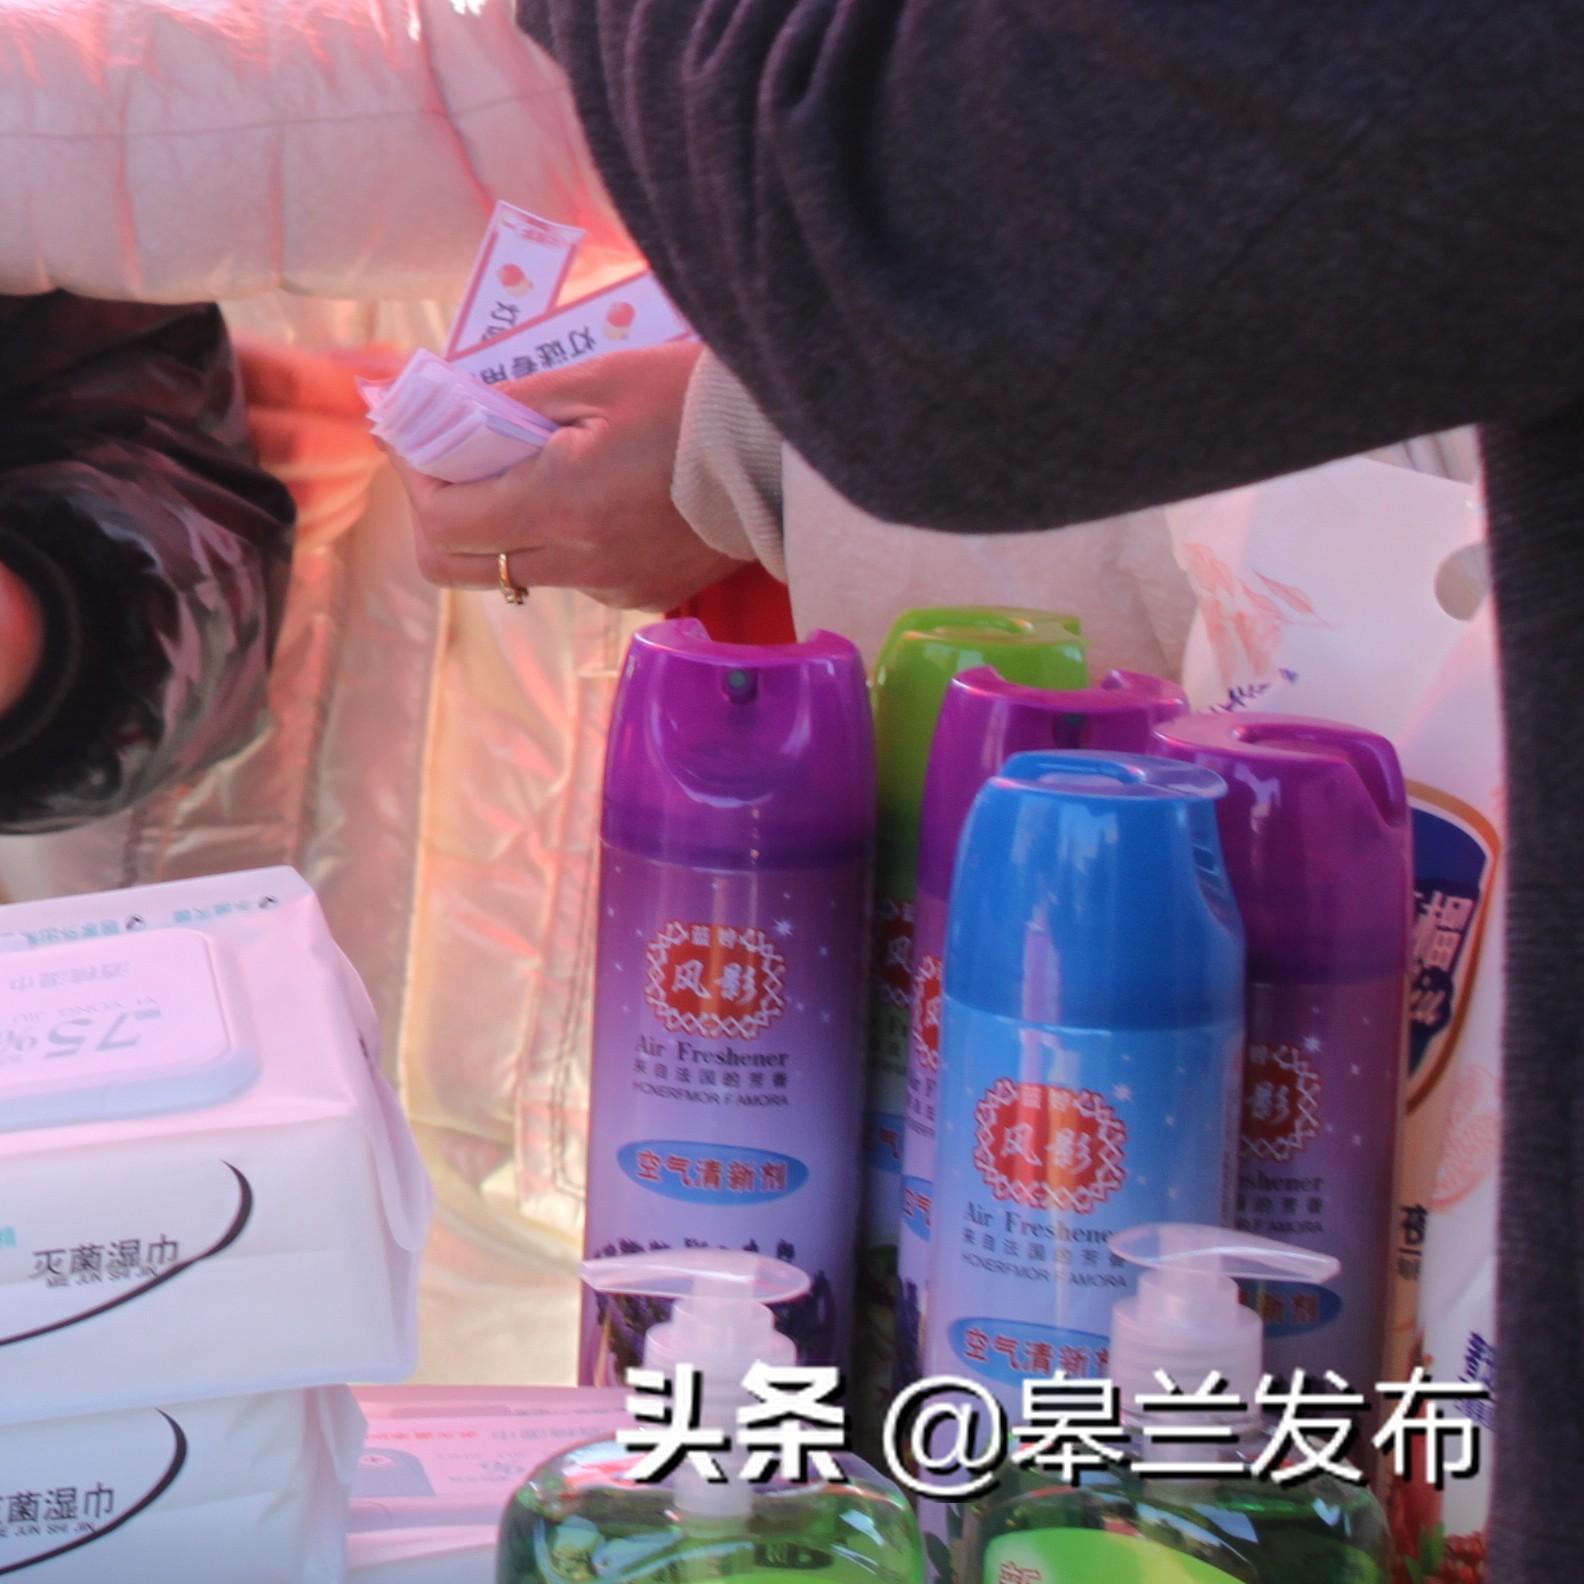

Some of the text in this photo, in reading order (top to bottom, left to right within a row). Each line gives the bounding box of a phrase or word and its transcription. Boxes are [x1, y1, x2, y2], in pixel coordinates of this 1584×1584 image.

[672, 958, 757, 1003] 风影
[635, 1033, 790, 1068] Air Freshener
[1002, 1121, 1092, 1176] 风影
[635, 1149, 789, 1193] 空气清新剂
[964, 1200, 993, 1227] Air
[29, 1232, 182, 1281] 灭菌湿巾
